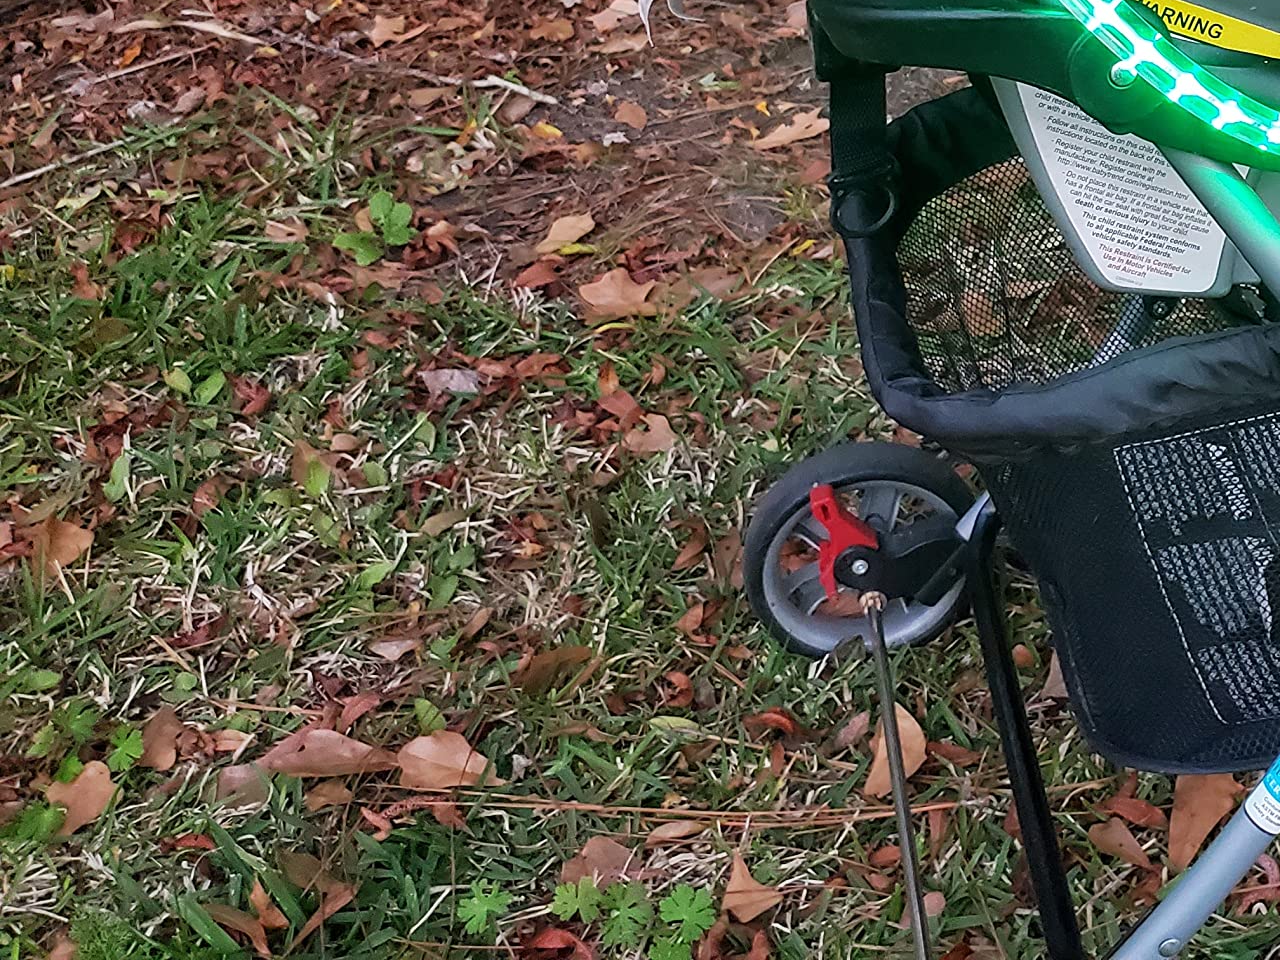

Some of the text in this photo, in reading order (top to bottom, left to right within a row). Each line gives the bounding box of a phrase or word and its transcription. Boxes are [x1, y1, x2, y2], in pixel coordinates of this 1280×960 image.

[1034, 92, 1051, 102] child
[1082, 211, 1200, 250] This child restraint system conforms
[1092, 231, 1116, 242] vehicle
[1117, 239, 1137, 250] safety
[1104, 227, 1139, 241] applicable
[1139, 236, 1165, 248] Federal
[1165, 245, 1185, 254] motor
[1099, 243, 1113, 253] This
[1114, 248, 1145, 262] Restraint
[1153, 259, 1181, 272] Certified
[1181, 266, 1191, 274] for
[1103, 252, 1116, 261] Use
[1125, 259, 1145, 269] Motor
[1146, 265, 1173, 277] Vehicles
[1107, 263, 1147, 278] and Aircraft
